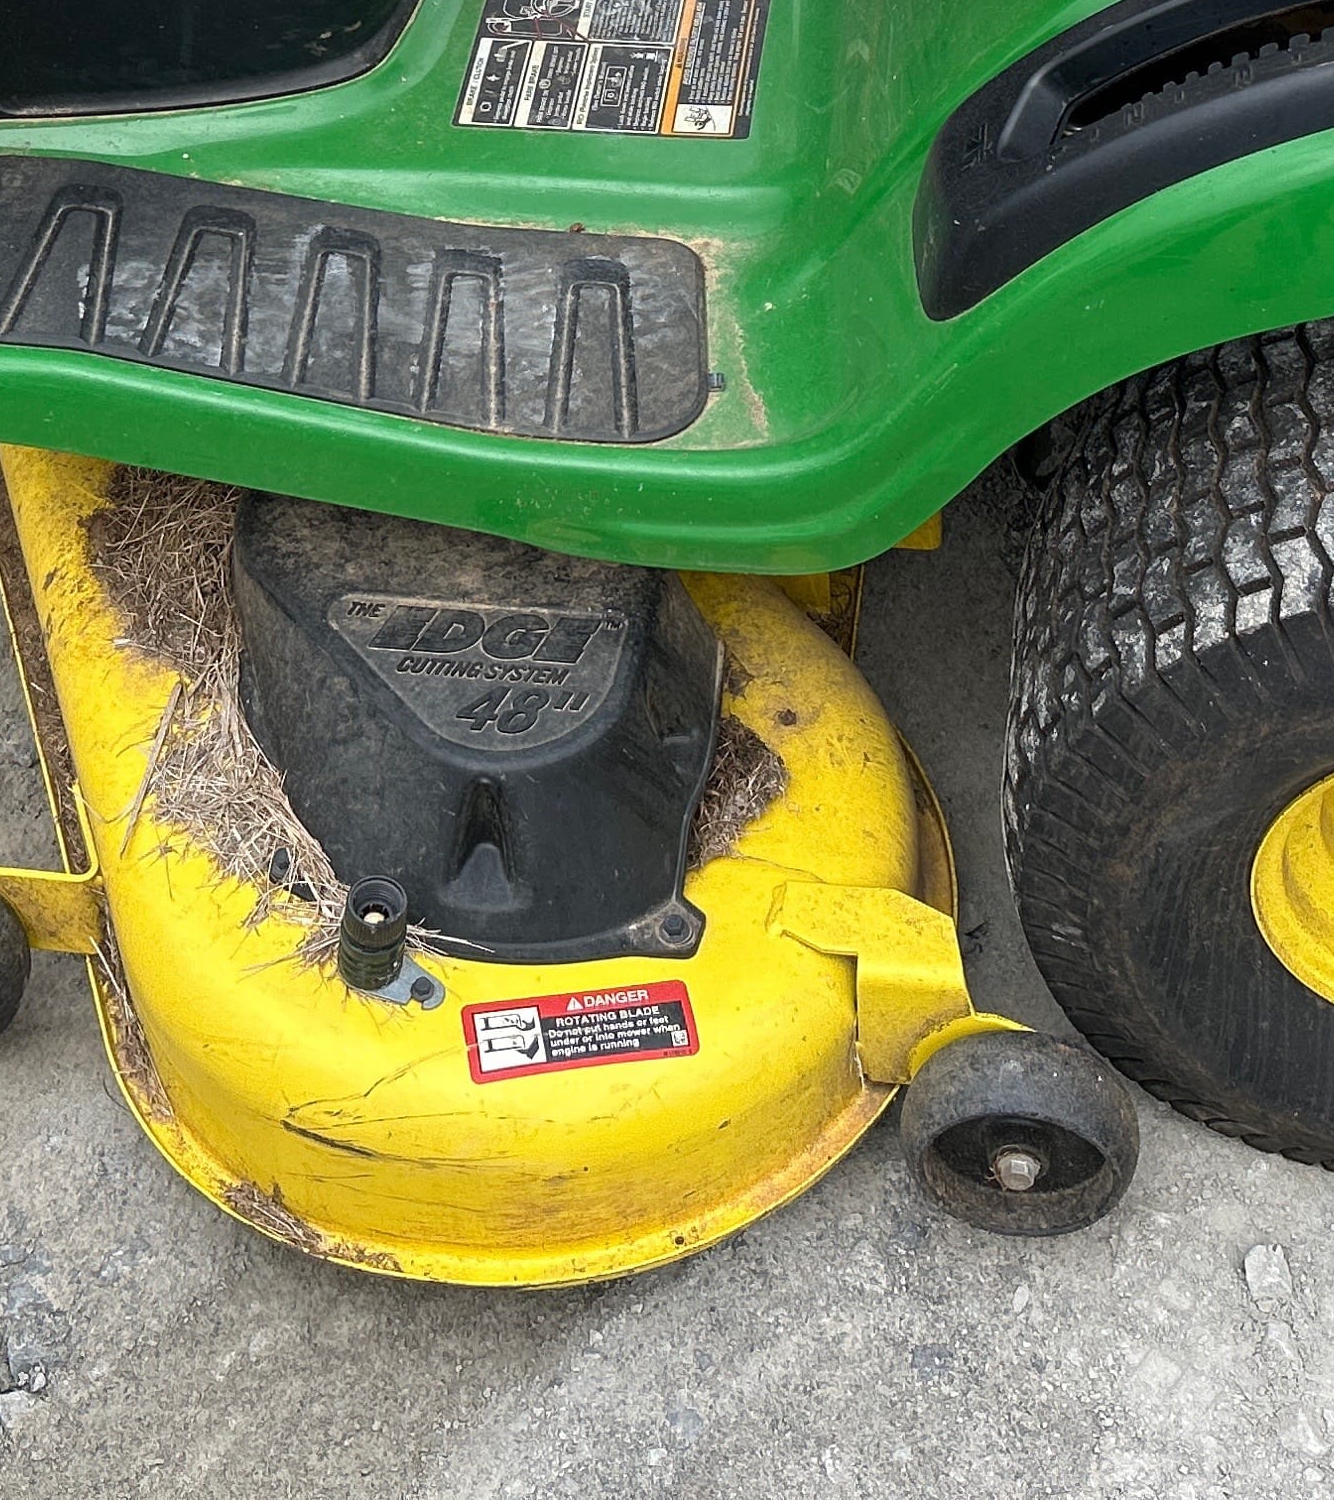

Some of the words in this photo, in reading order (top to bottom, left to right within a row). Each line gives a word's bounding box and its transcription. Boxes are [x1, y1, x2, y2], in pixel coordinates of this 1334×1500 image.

[347, 601, 386, 618] THE
[367, 604, 603, 665] EDGE
[395, 655, 484, 680] CUTTING
[484, 664, 570, 687] SYSTEM
[583, 989, 650, 1009] DANGER
[548, 1028, 563, 1039] Do
[584, 1023, 601, 1036] put
[603, 1018, 634, 1032] hands
[637, 1018, 648, 1027] or
[649, 1013, 670, 1026] feet
[555, 1011, 617, 1028] ROTATING
[620, 1006, 660, 1020] BLADE
[549, 1036, 580, 1048] under
[582, 1034, 593, 1044] or
[595, 1030, 615, 1042] into
[617, 1027, 651, 1041] mower
[653, 1022, 681, 1035] when
[551, 1044, 585, 1057] engine
[587, 1040, 598, 1051] is
[600, 1037, 640, 1051] running
